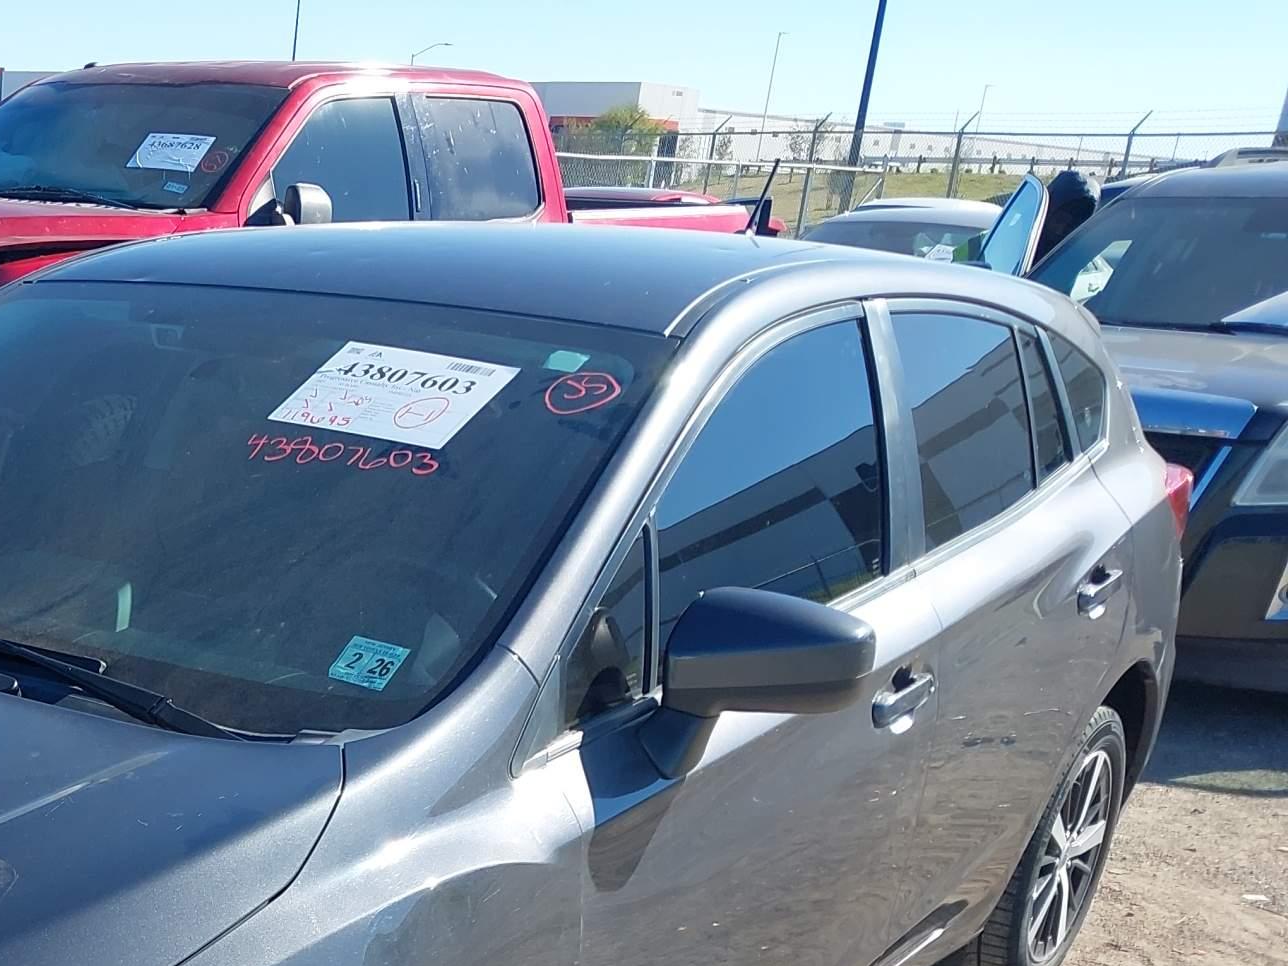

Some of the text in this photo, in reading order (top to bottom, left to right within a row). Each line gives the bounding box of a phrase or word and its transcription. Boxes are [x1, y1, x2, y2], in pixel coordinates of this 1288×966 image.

[336, 361, 478, 395] 43807603
[247, 433, 440, 476] 43807603
[343, 652, 395, 677] 2 26
